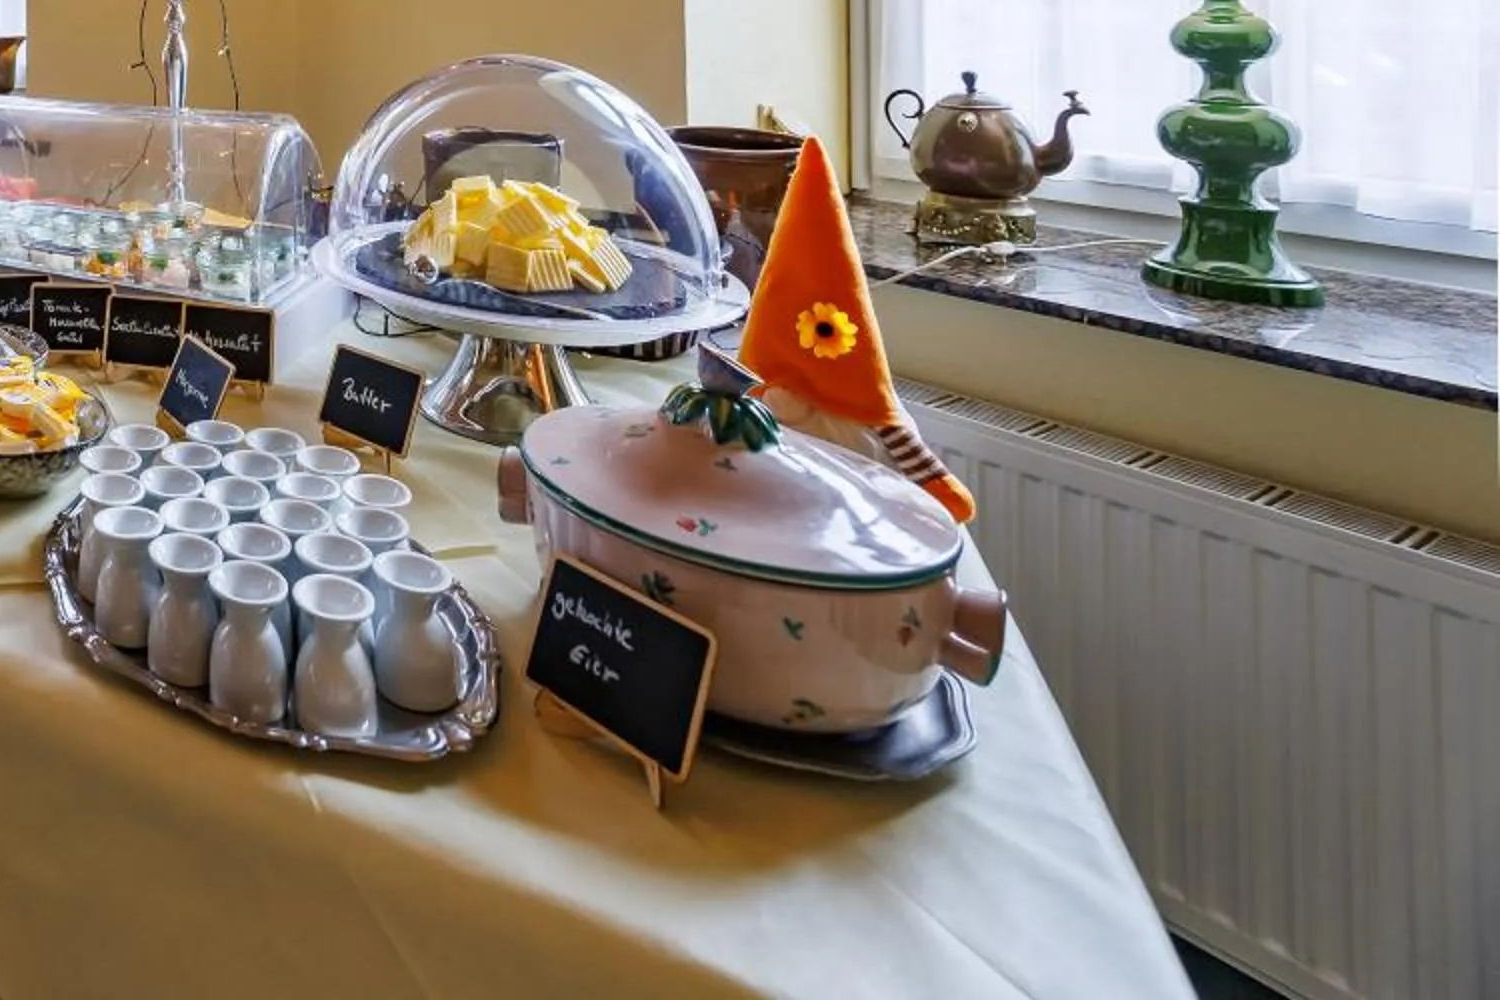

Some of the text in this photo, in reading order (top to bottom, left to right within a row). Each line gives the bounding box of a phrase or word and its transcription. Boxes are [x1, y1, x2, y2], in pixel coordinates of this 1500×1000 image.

[341, 377, 394, 414] Butter
[550, 590, 636, 652] gekochte
[569, 644, 621, 683] Eier
